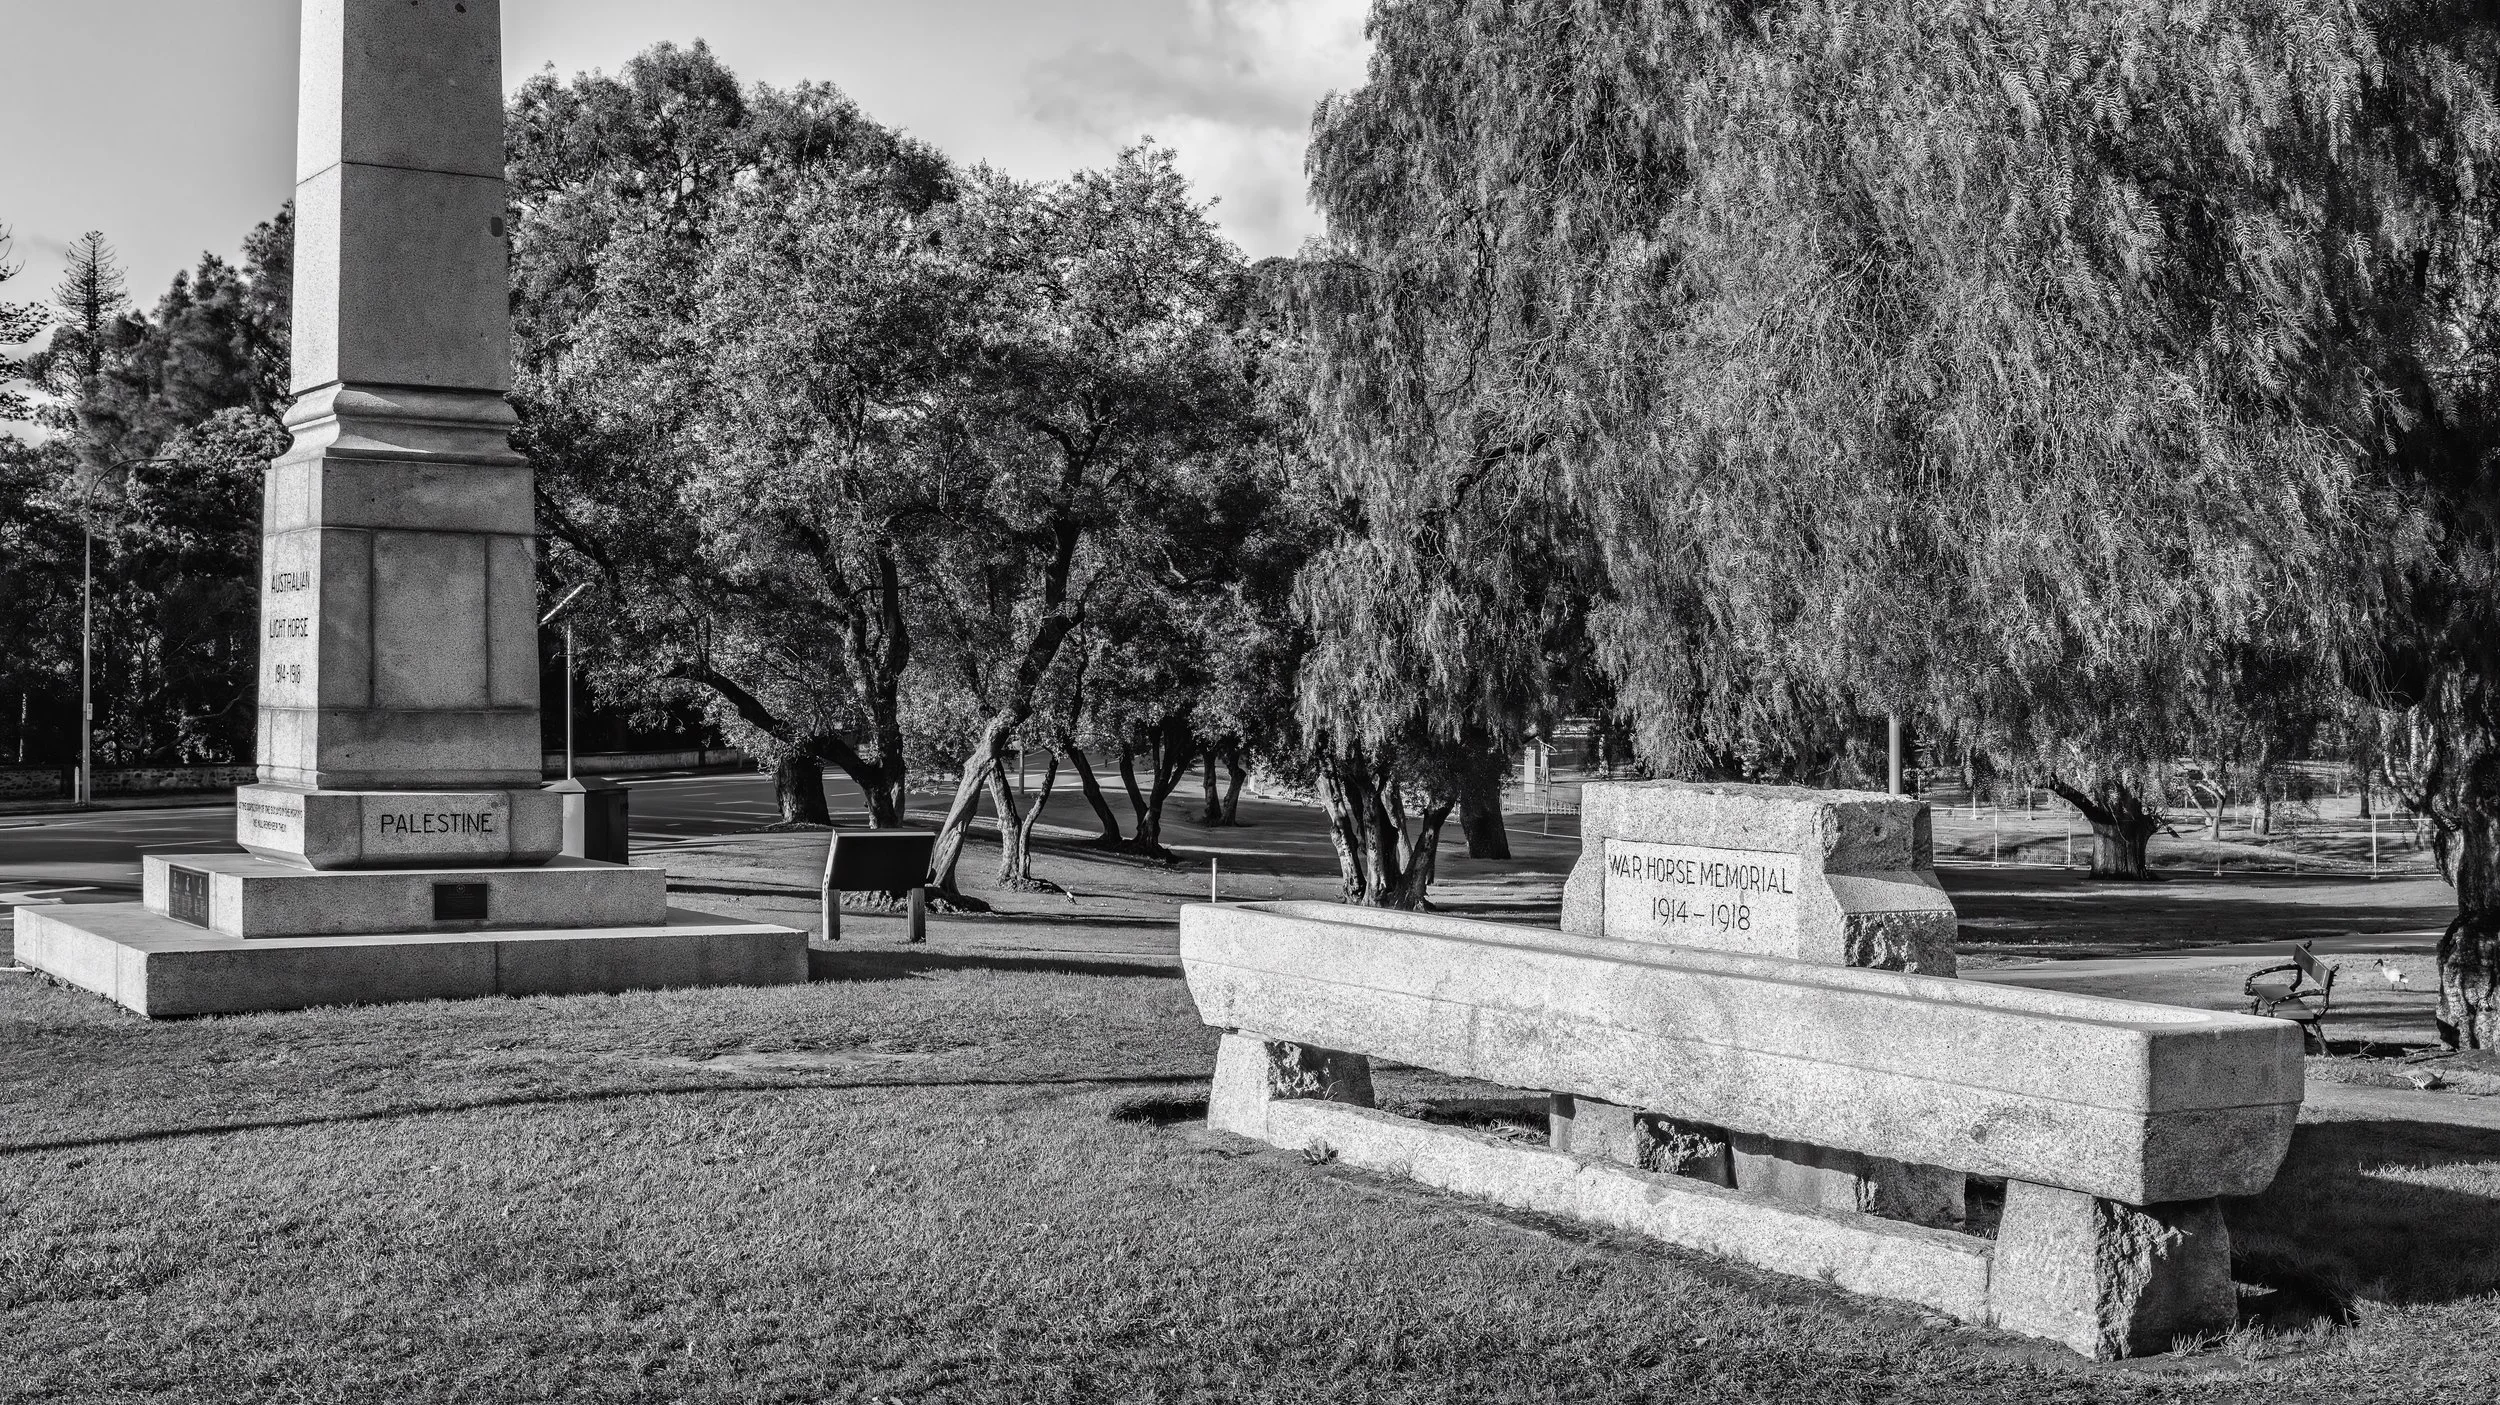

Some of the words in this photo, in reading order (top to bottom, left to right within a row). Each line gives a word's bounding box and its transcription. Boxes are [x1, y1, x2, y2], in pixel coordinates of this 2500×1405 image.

[271, 571, 310, 593] AUSTRALIAN
[269, 619, 286, 638] LIGHT
[287, 617, 308, 637] HORSE
[381, 813, 493, 833] PALESTINE
[1608, 854, 1642, 883] WAR
[1647, 857, 1696, 885] HORSE
[1700, 862, 1793, 894] MEMORIAL
